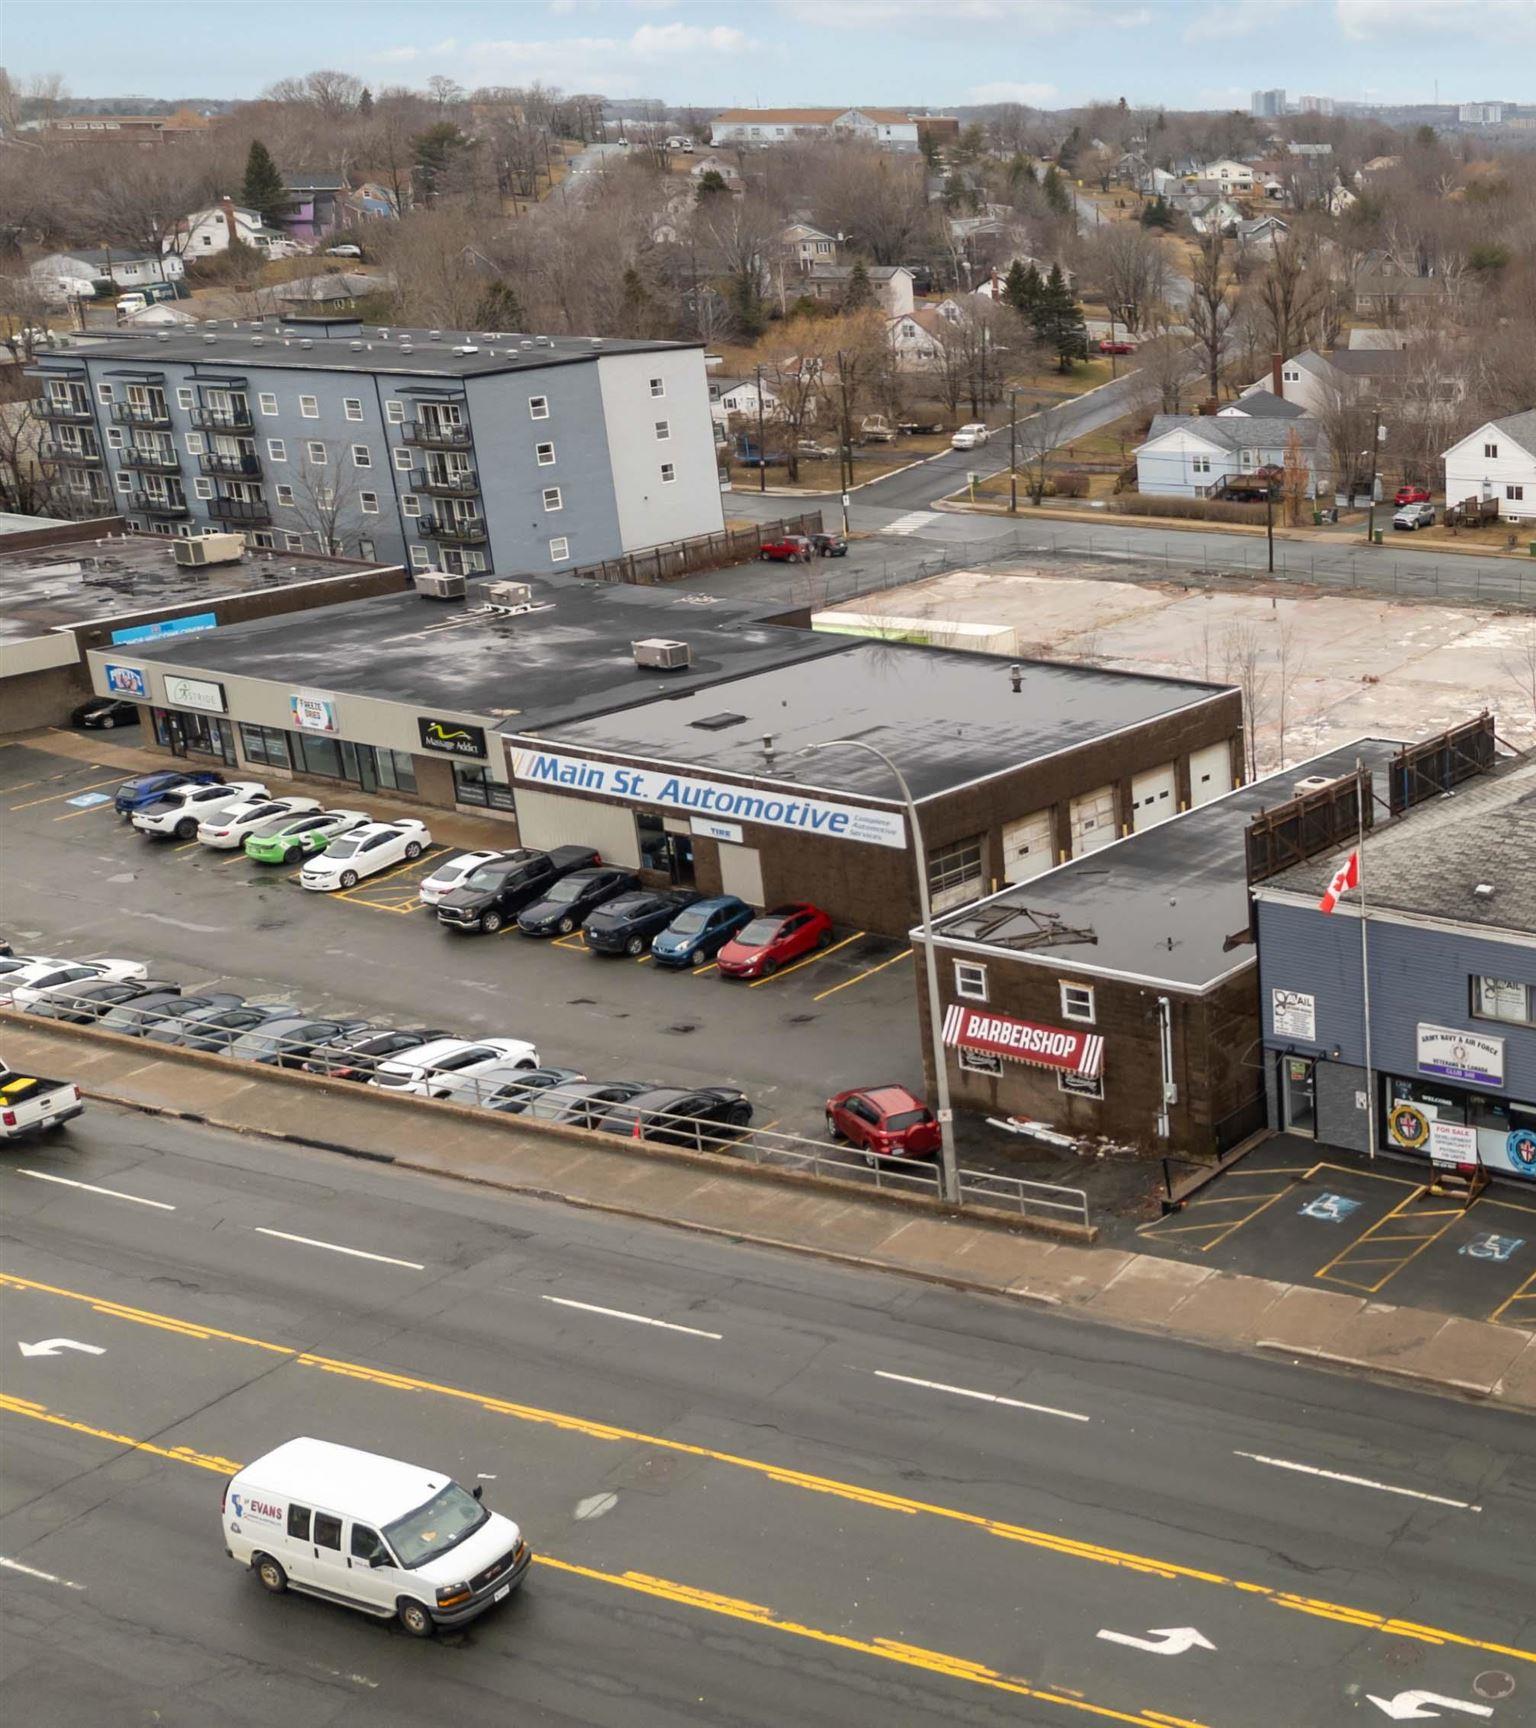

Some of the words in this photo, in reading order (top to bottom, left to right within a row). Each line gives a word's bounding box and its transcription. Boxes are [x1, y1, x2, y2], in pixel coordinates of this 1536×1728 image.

[531, 756, 604, 789] Main
[610, 770, 649, 798] St.
[656, 779, 849, 833] Automotive
[967, 1015, 1076, 1057] BARBERSHOP
[1421, 1034, 1439, 1042] ARMY
[1465, 1037, 1476, 1047] AIR
[1477, 1041, 1499, 1056] FORCE
[1432, 1058, 1459, 1069] VETERANS
[1422, 1095, 1453, 1106] WELCOME
[251, 1500, 282, 1520] EVANS
